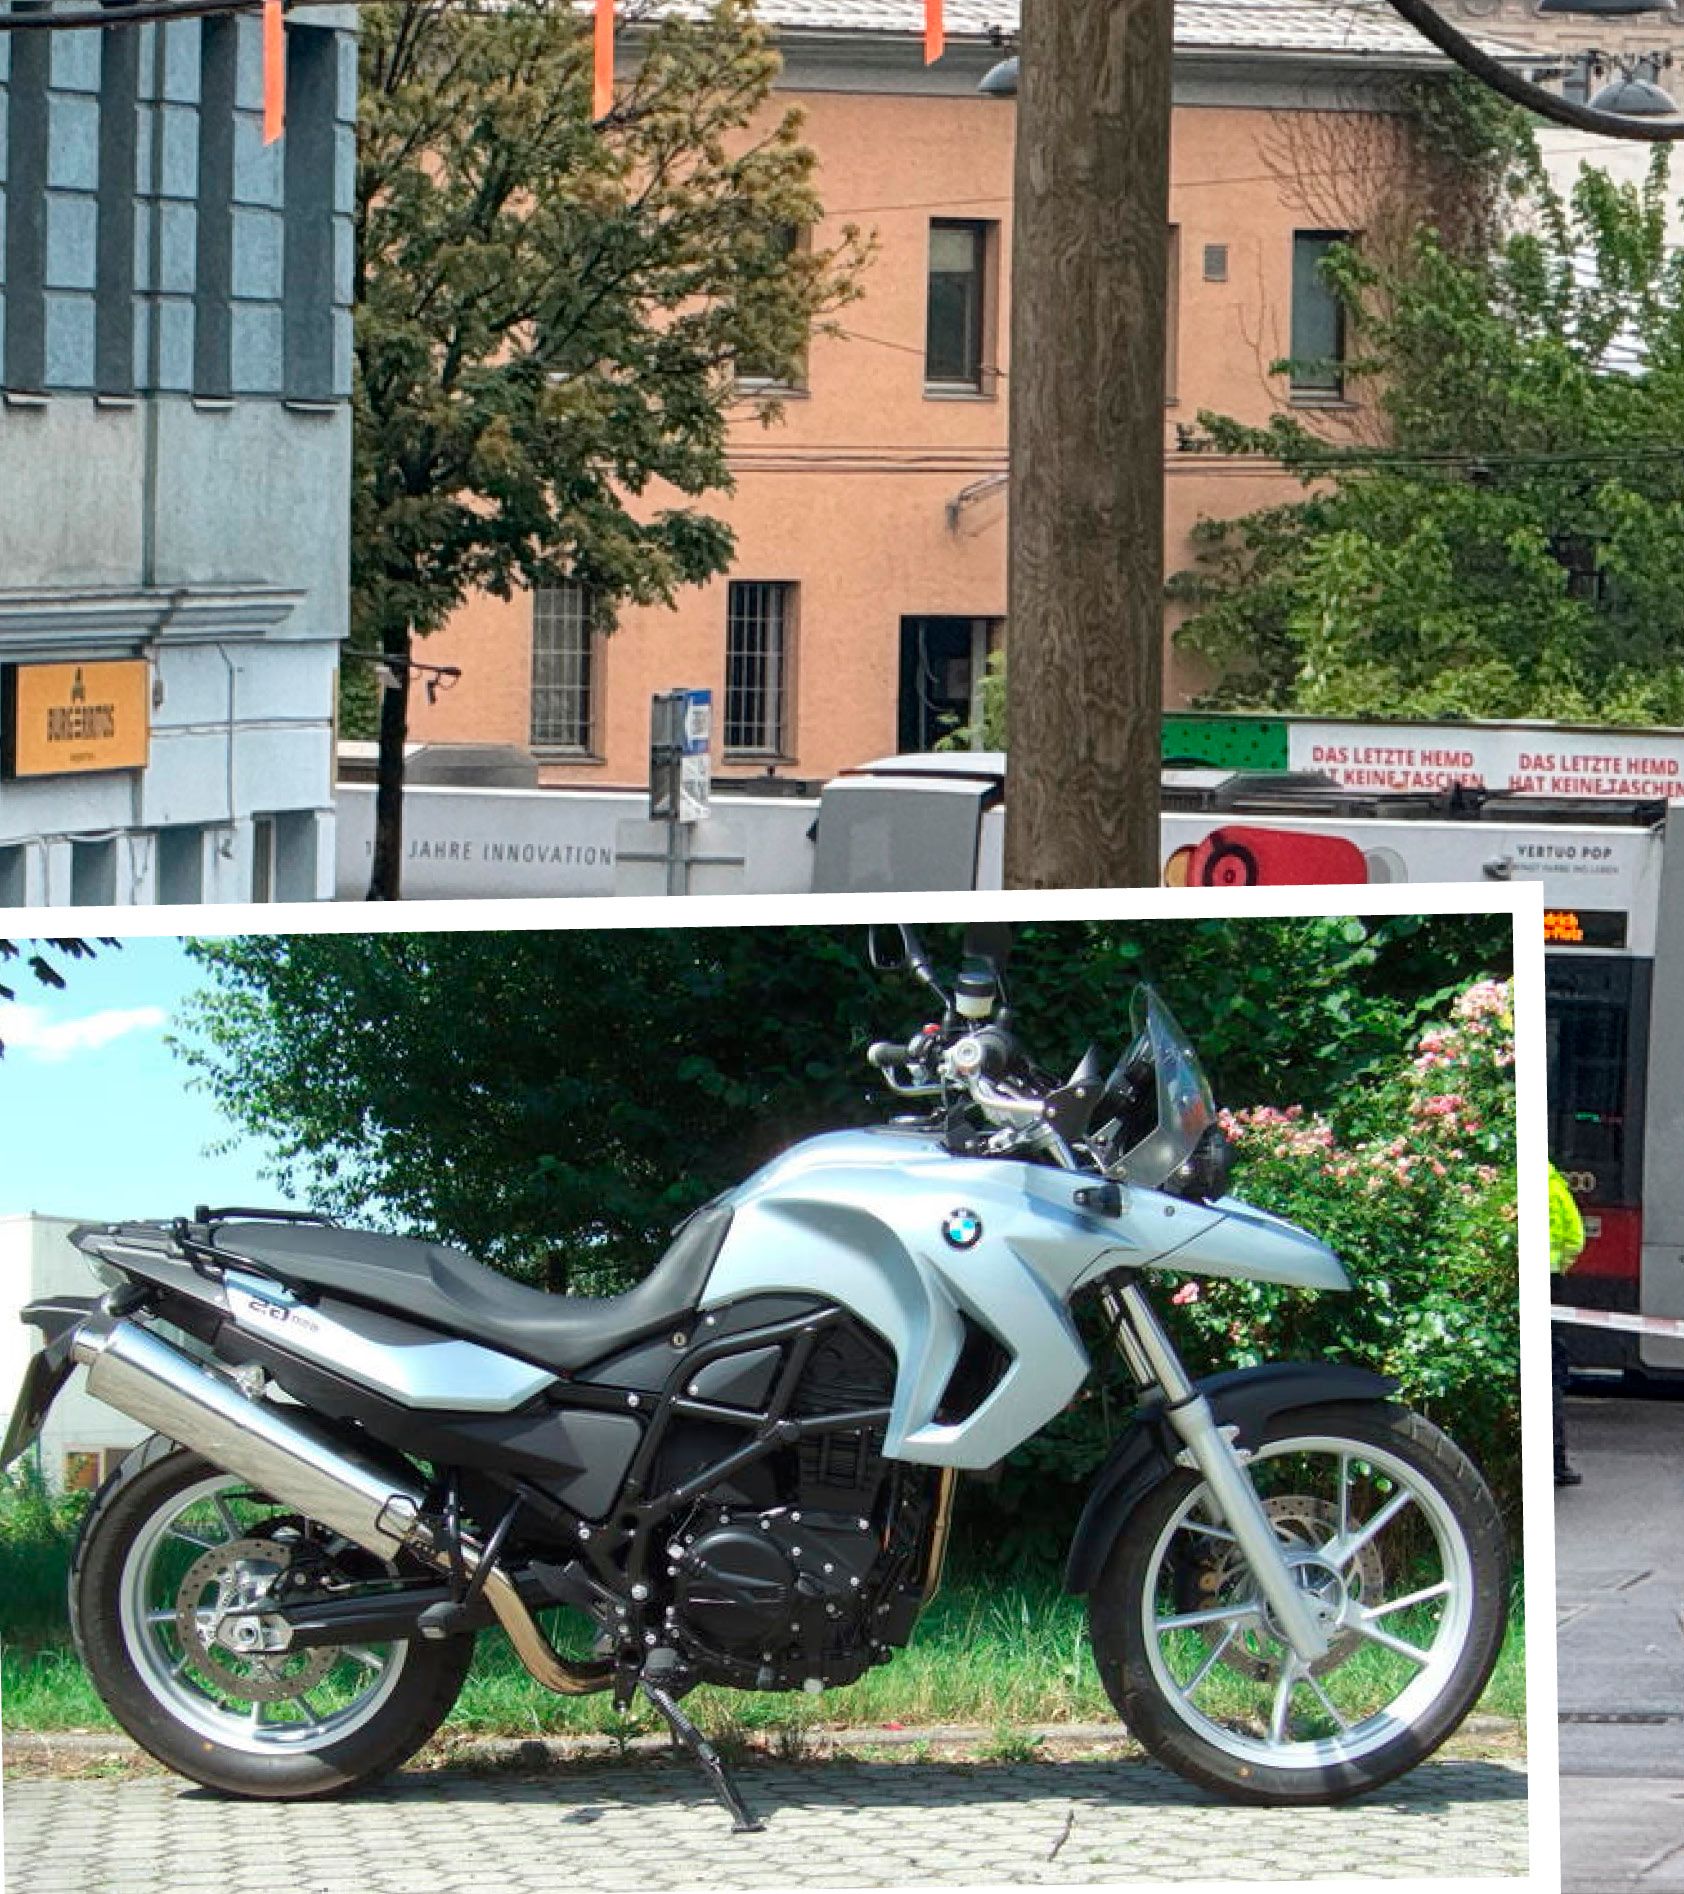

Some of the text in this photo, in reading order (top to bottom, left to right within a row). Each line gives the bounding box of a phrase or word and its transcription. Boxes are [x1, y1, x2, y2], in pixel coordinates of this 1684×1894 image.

[1312, 745, 1475, 768] DAS LETZTE HEMD
[1518, 752, 1680, 775] DAS LETZTE HEMD
[1343, 769, 1398, 787] KEINE
[1508, 775, 1546, 793] HAT
[1551, 776, 1602, 794] KEINE
[408, 840, 473, 860] JAHRE
[482, 843, 612, 866] INNOVATION
[1581, 846, 1612, 860] POP
